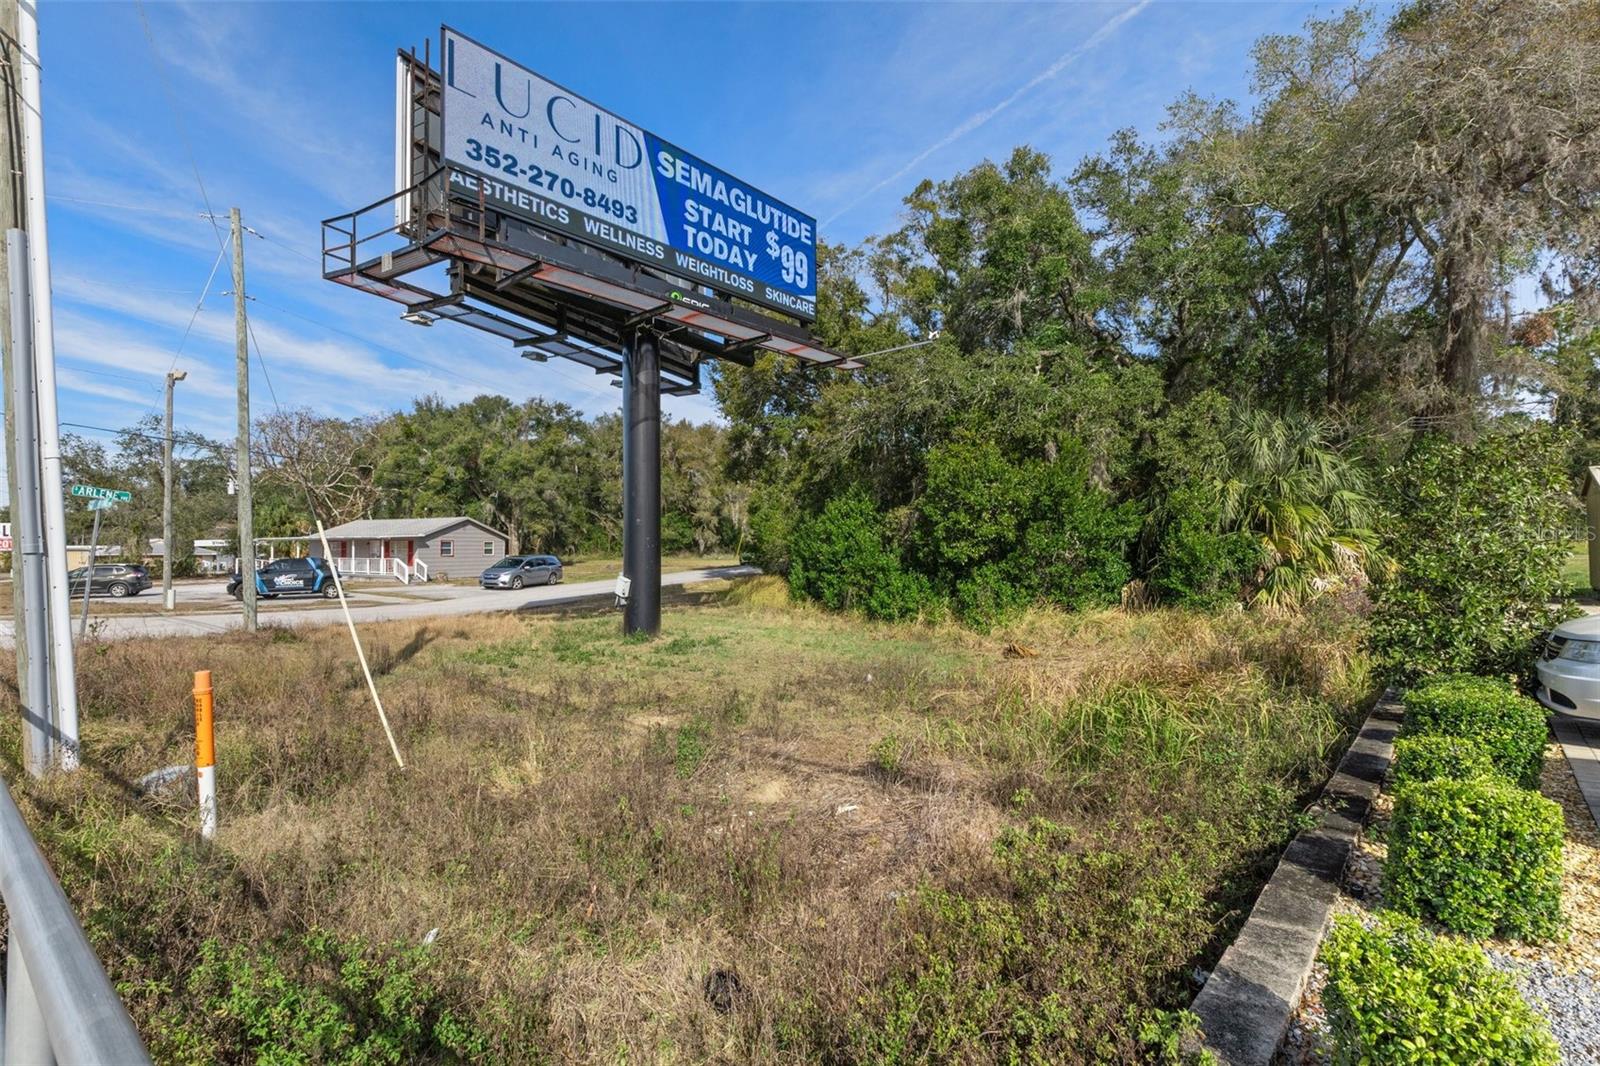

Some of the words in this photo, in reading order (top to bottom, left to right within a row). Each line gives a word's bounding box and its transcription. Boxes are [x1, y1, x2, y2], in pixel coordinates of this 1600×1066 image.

[447, 37, 642, 169] LUCID
[466, 138, 637, 224] 352-270-8493
[481, 112, 537, 148] ANTI
[552, 145, 618, 183] AGING
[656, 151, 812, 246] SEMAGLUTIDE
[683, 199, 752, 246] START
[450, 166, 570, 224] AESTHETICS
[584, 216, 665, 260] WELLNESS
[675, 252, 754, 293] WEIGHTLOSS
[765, 287, 815, 315] SKINCARE
[683, 224, 758, 273] TODAY
[765, 230, 809, 289] $99
[78, 486, 119, 501] ARLENE
